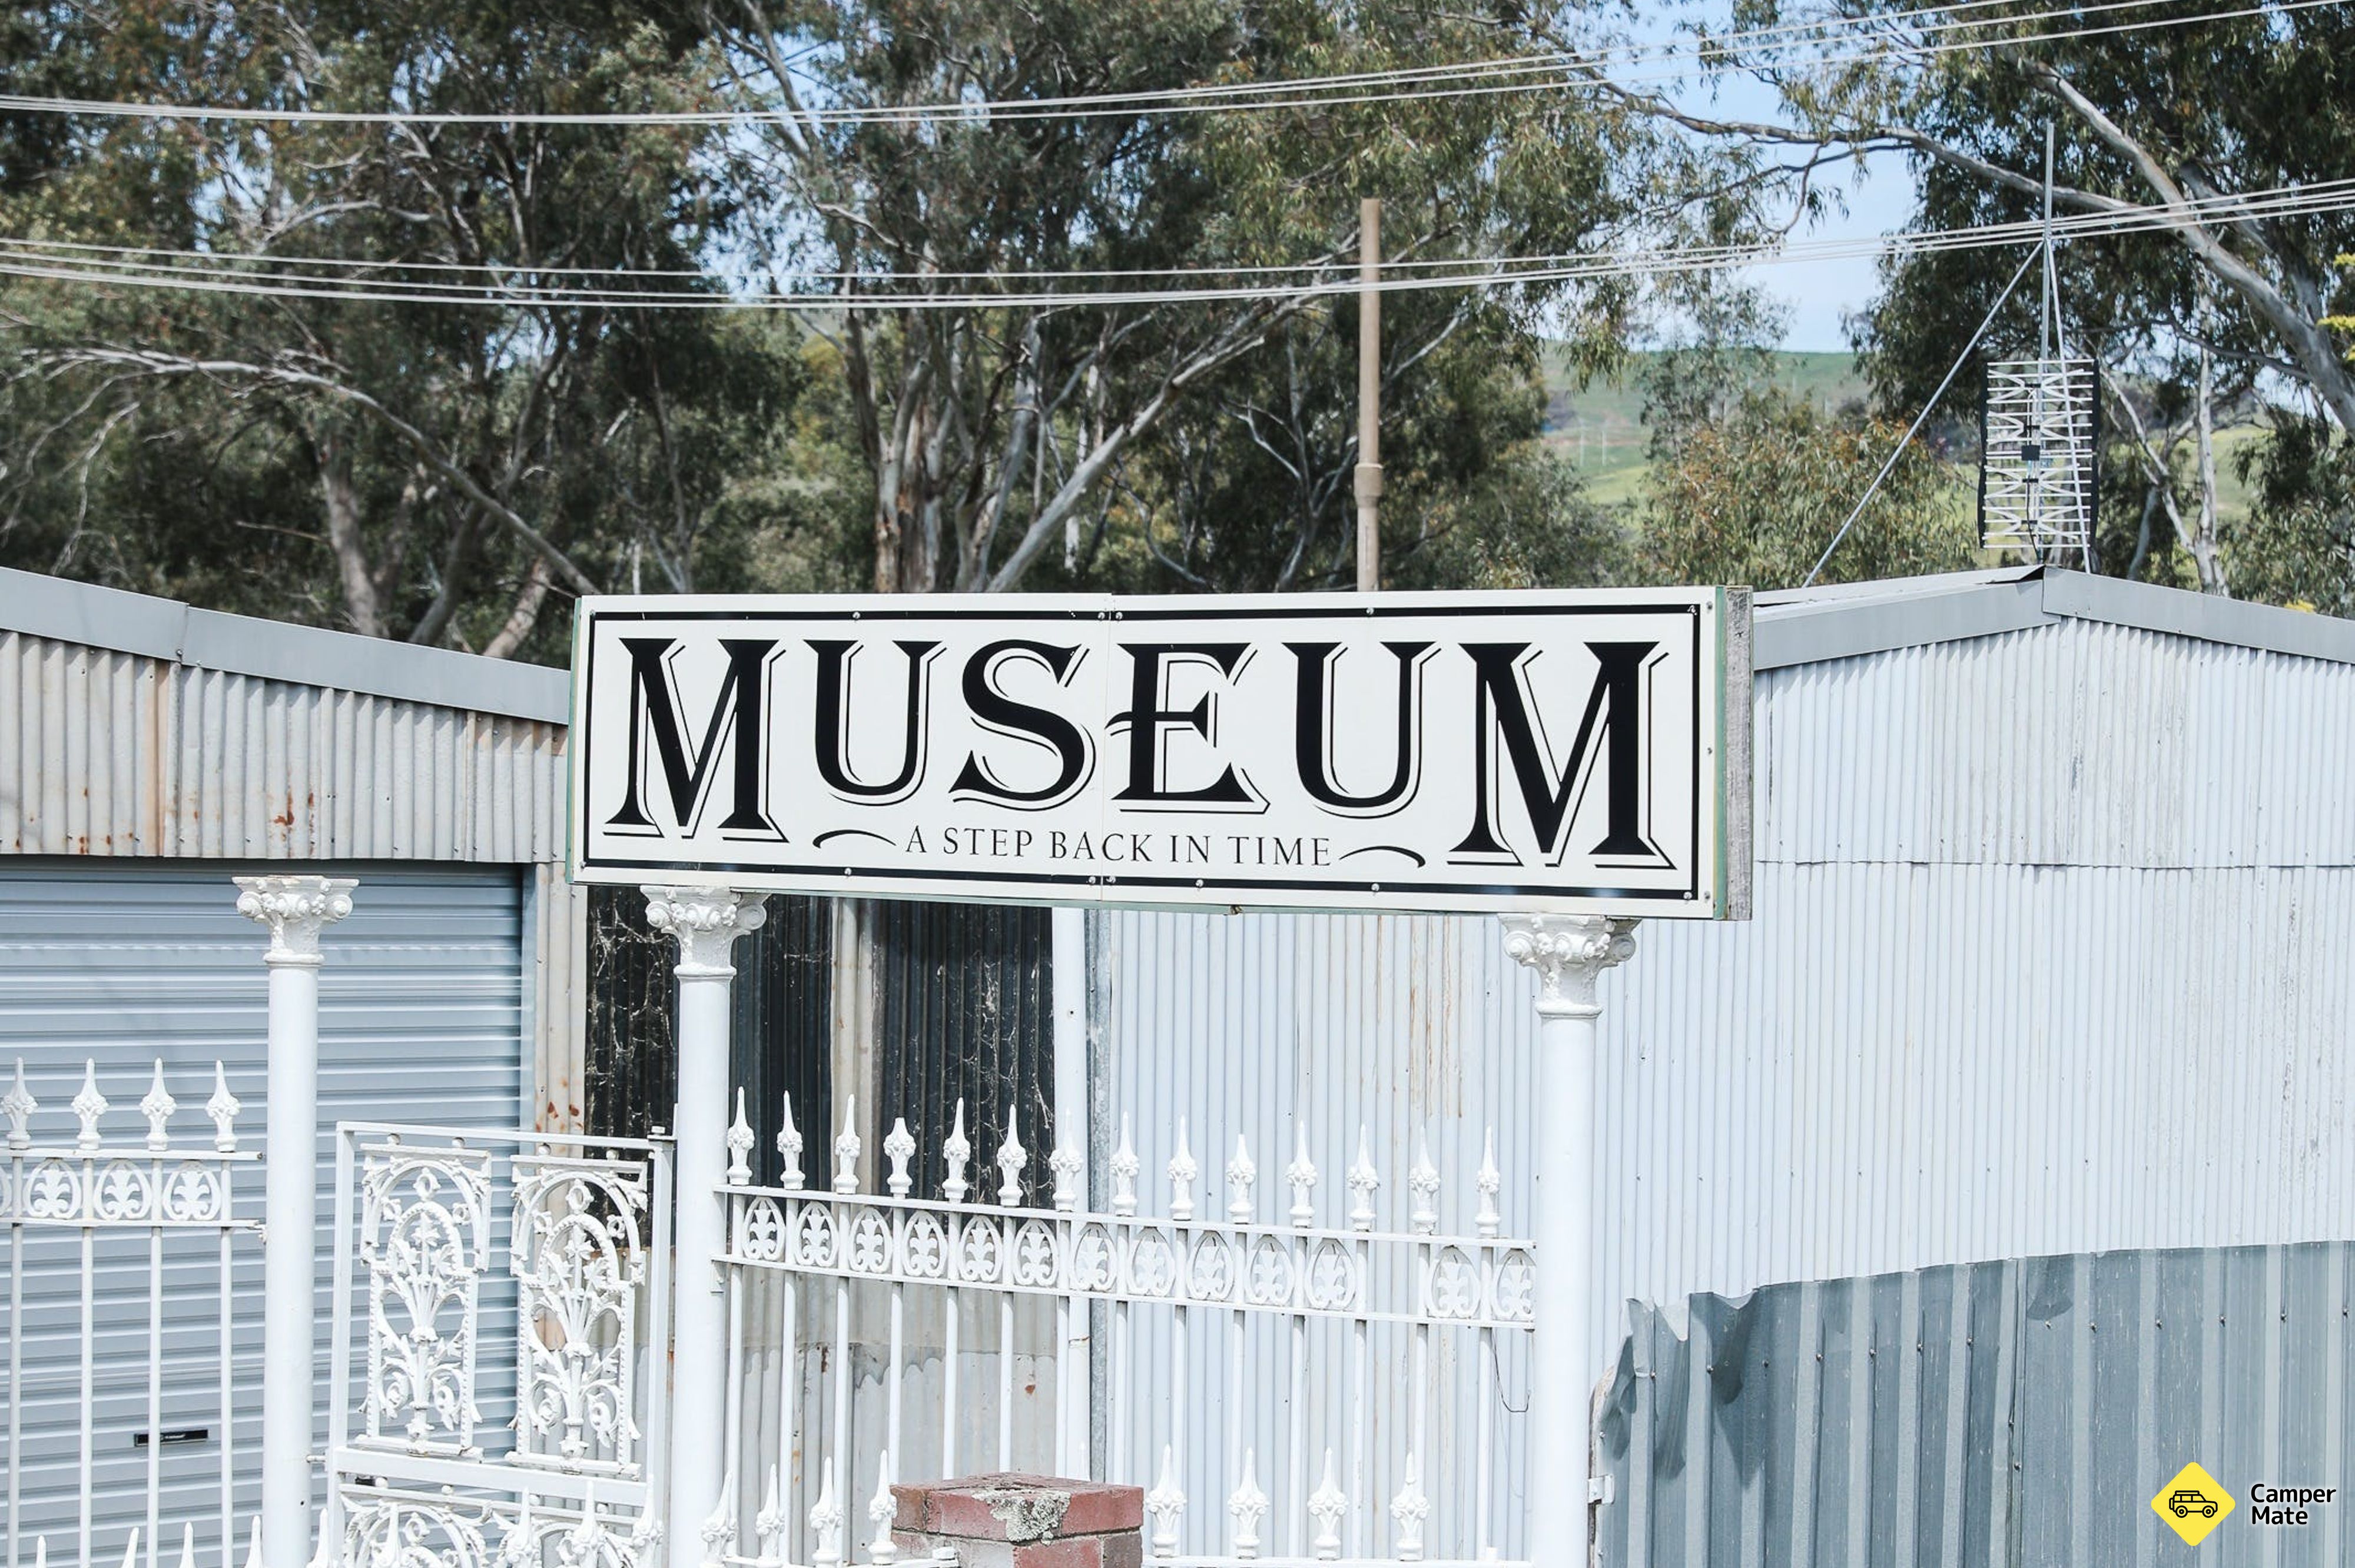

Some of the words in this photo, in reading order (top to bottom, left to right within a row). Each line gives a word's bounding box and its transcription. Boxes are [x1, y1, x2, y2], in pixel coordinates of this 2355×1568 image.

[603, 637, 1677, 870] MUSEUM
[905, 824, 927, 853] A
[943, 826, 1032, 858] STEP
[1049, 829, 1153, 862] BACK
[1170, 835, 1210, 865] IN
[1227, 835, 1331, 867] TIME
